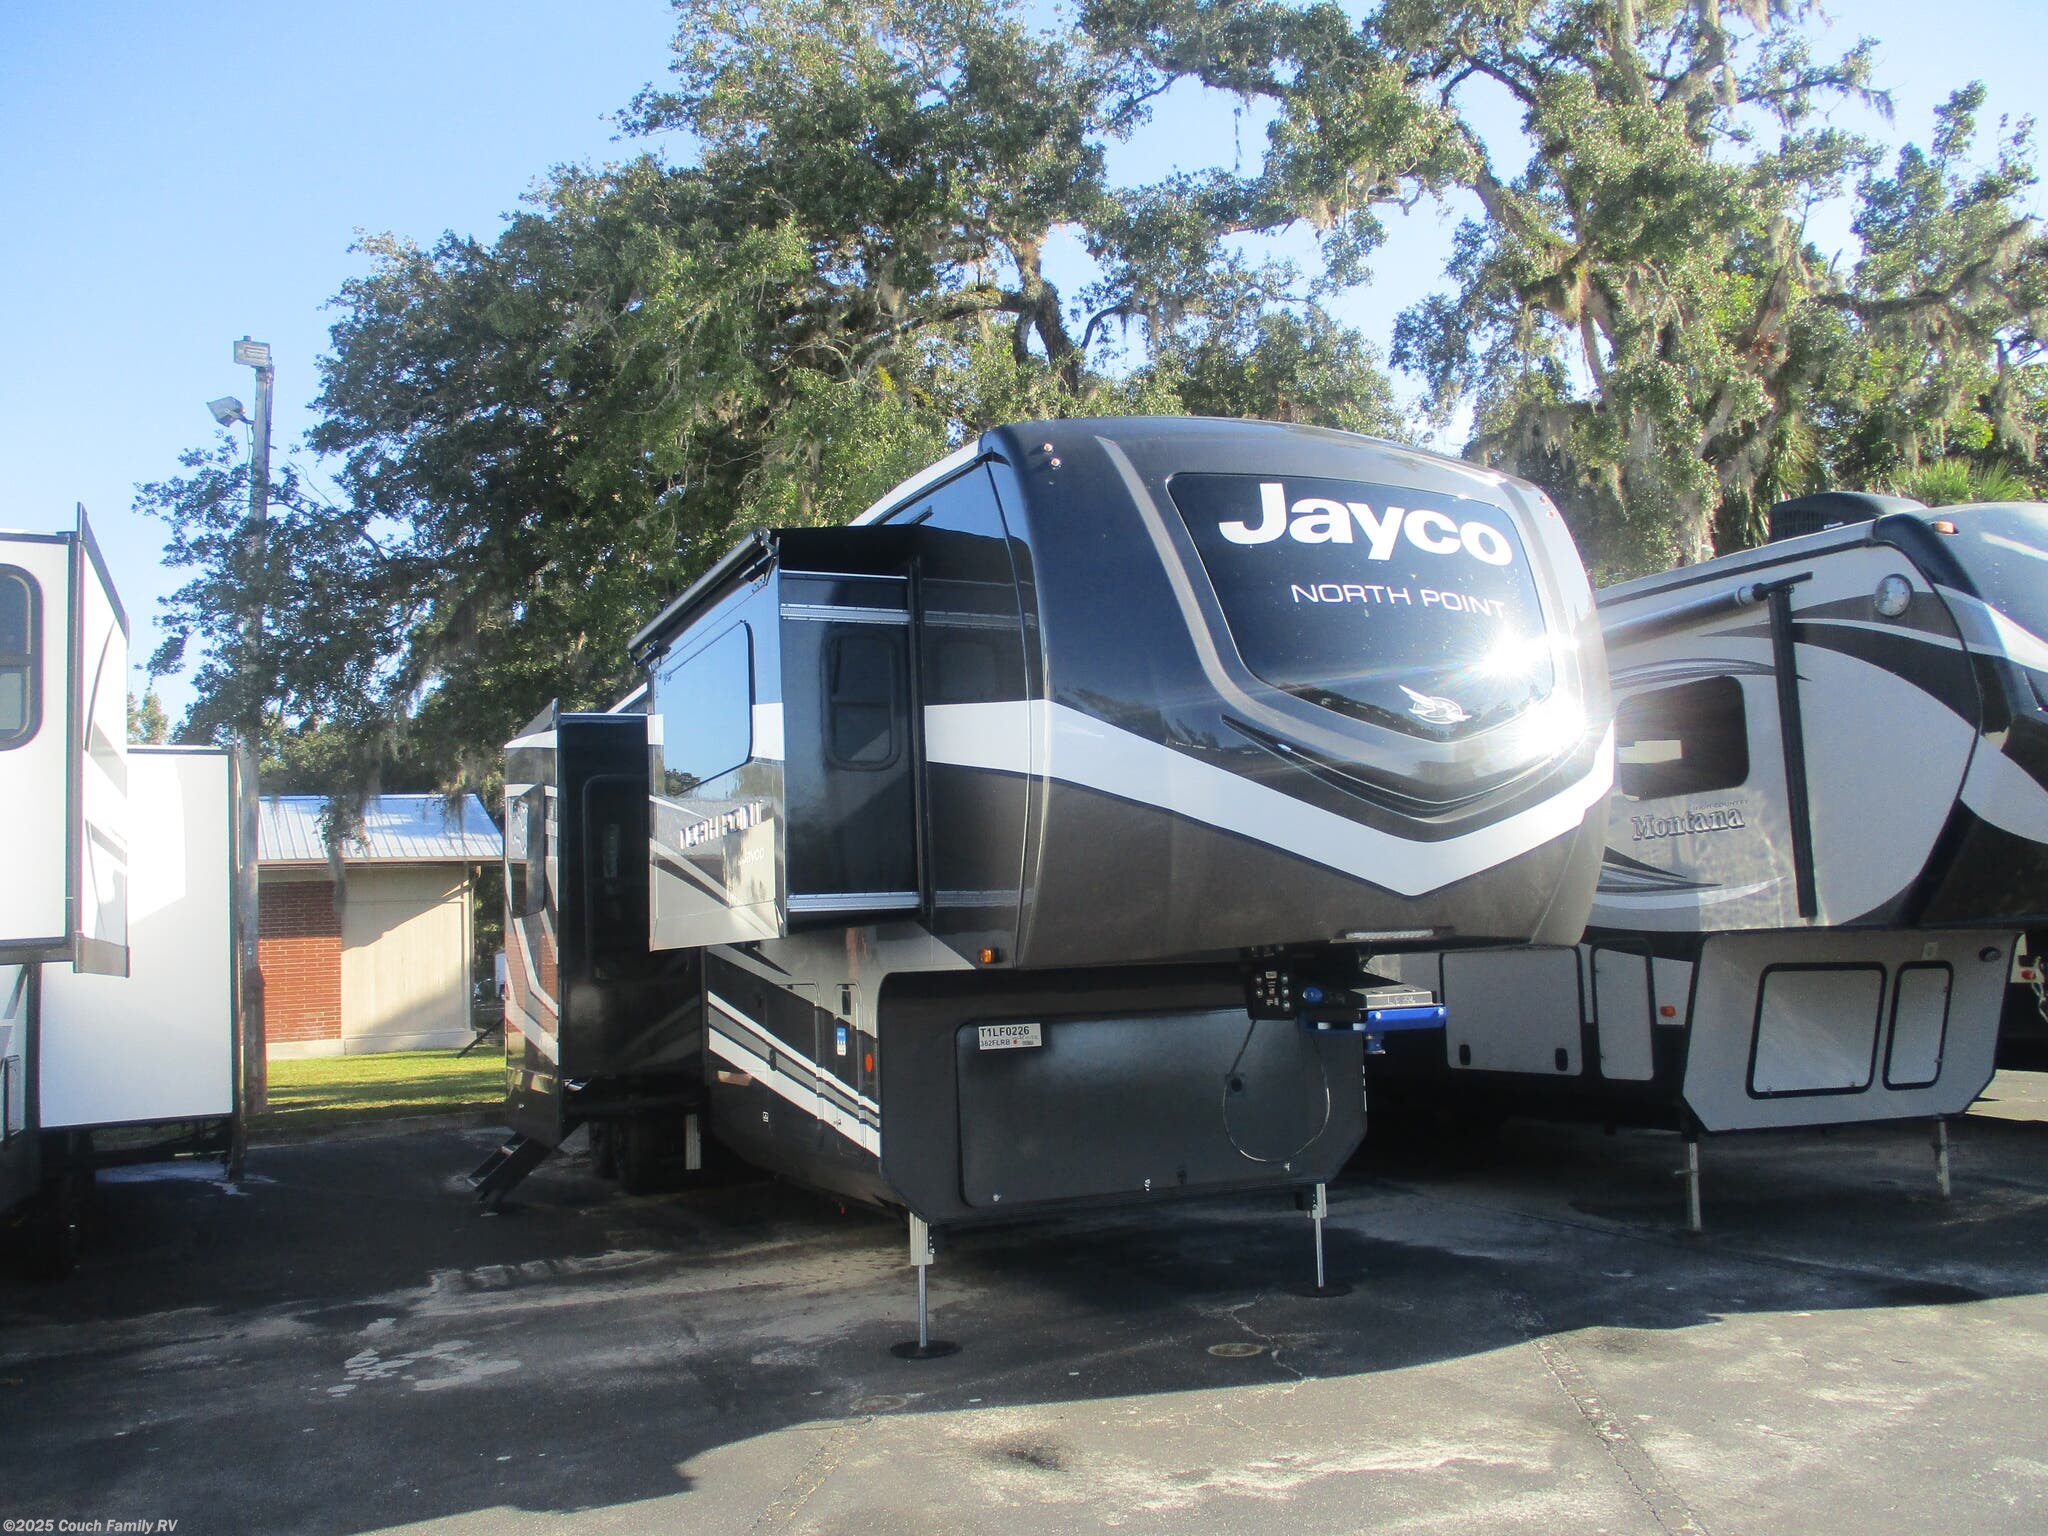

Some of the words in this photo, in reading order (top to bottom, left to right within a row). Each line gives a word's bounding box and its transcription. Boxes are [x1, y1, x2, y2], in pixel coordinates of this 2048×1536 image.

[1218, 483, 1513, 566] Jayco
[1290, 584, 1412, 606] NORTH
[1420, 588, 1505, 619] POINT
[1631, 809, 1745, 840] Montana
[980, 1026, 1030, 1038] T1LF0226
